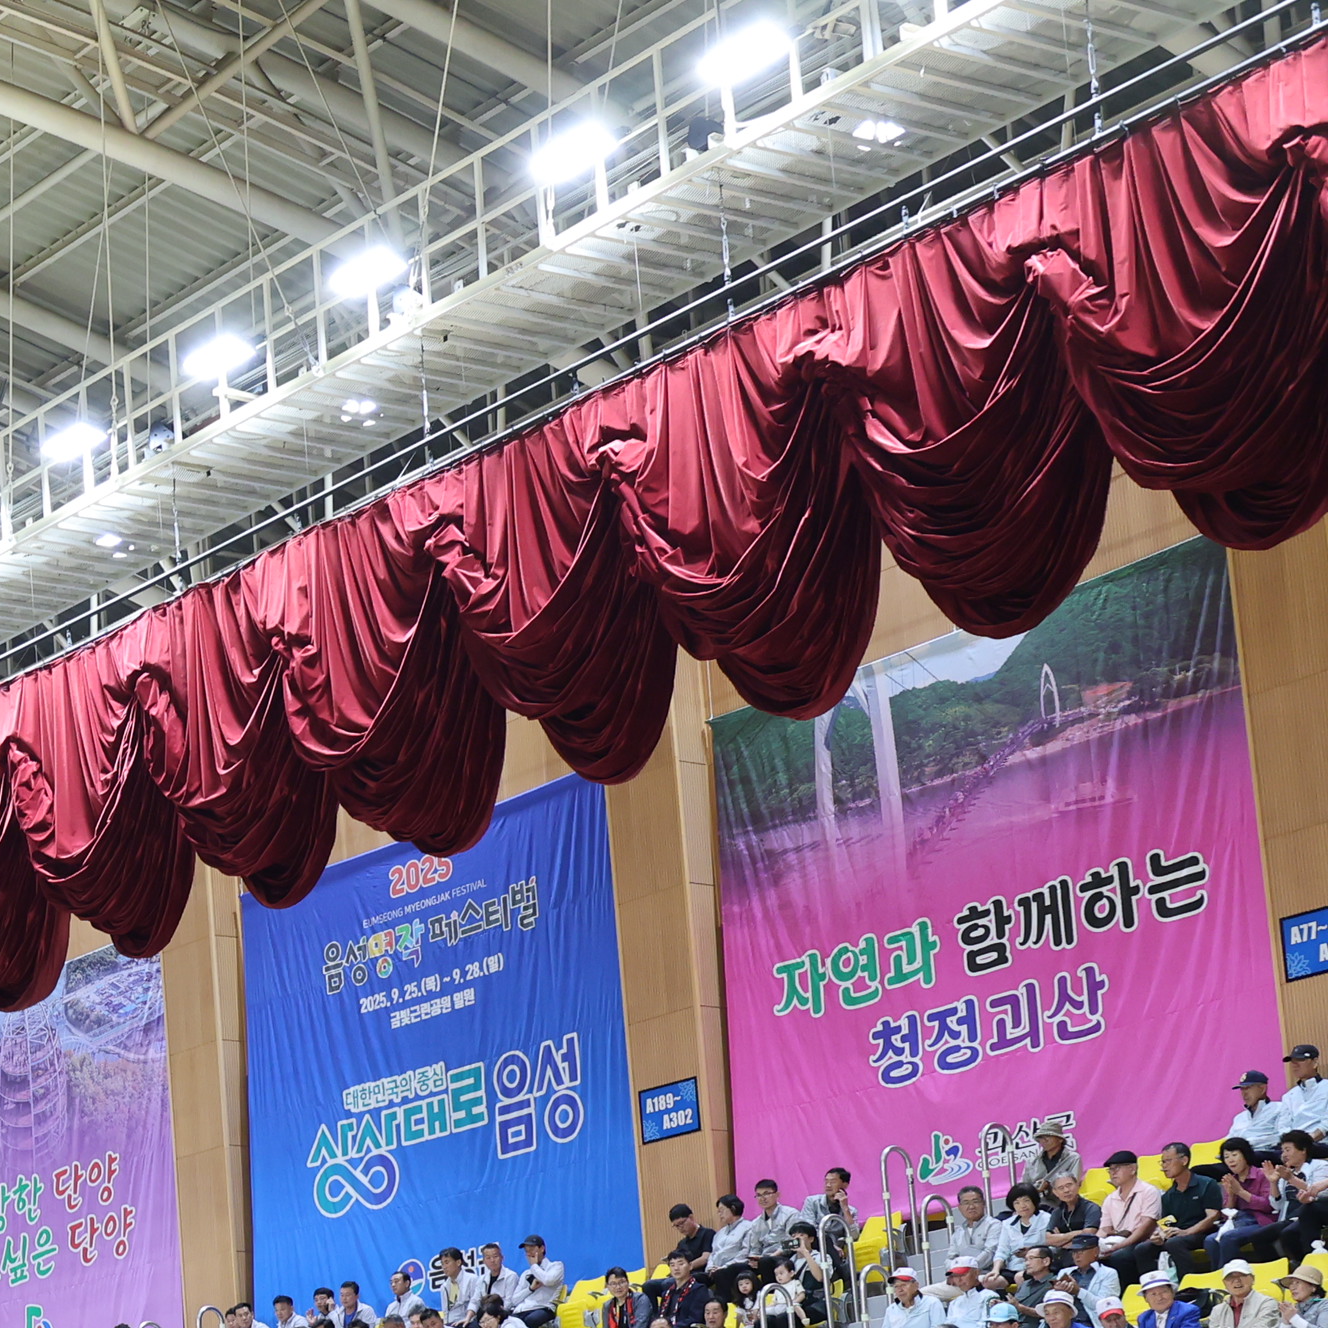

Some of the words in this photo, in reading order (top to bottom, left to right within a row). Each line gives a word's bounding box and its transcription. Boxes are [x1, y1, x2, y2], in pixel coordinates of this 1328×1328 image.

[363, 909, 404, 929] EUMSEONG
[404, 891, 451, 915] MYEONGJAK
[451, 878, 487, 899] FESTIVAL
[390, 854, 453, 898] 2025
[323, 918, 425, 995] 음성명작
[427, 876, 539, 946] 페스티벌
[774, 918, 940, 1018] 자연과
[956, 848, 1210, 976] 함께하는
[359, 991, 391, 1014] 2025.
[390, 995, 452, 1030] 금빛근린공원
[453, 987, 476, 1008] 일원
[870, 962, 1108, 1088] 청정괴산
[344, 1073, 413, 1111] 대한민국의
[417, 1061, 445, 1094] 중심
[307, 1062, 489, 1218] 상상대로
[493, 1032, 584, 1159] 음성
[662, 1107, 694, 1130] A302
[53, 1151, 120, 1212] 단양
[69, 1205, 135, 1266] 단양
